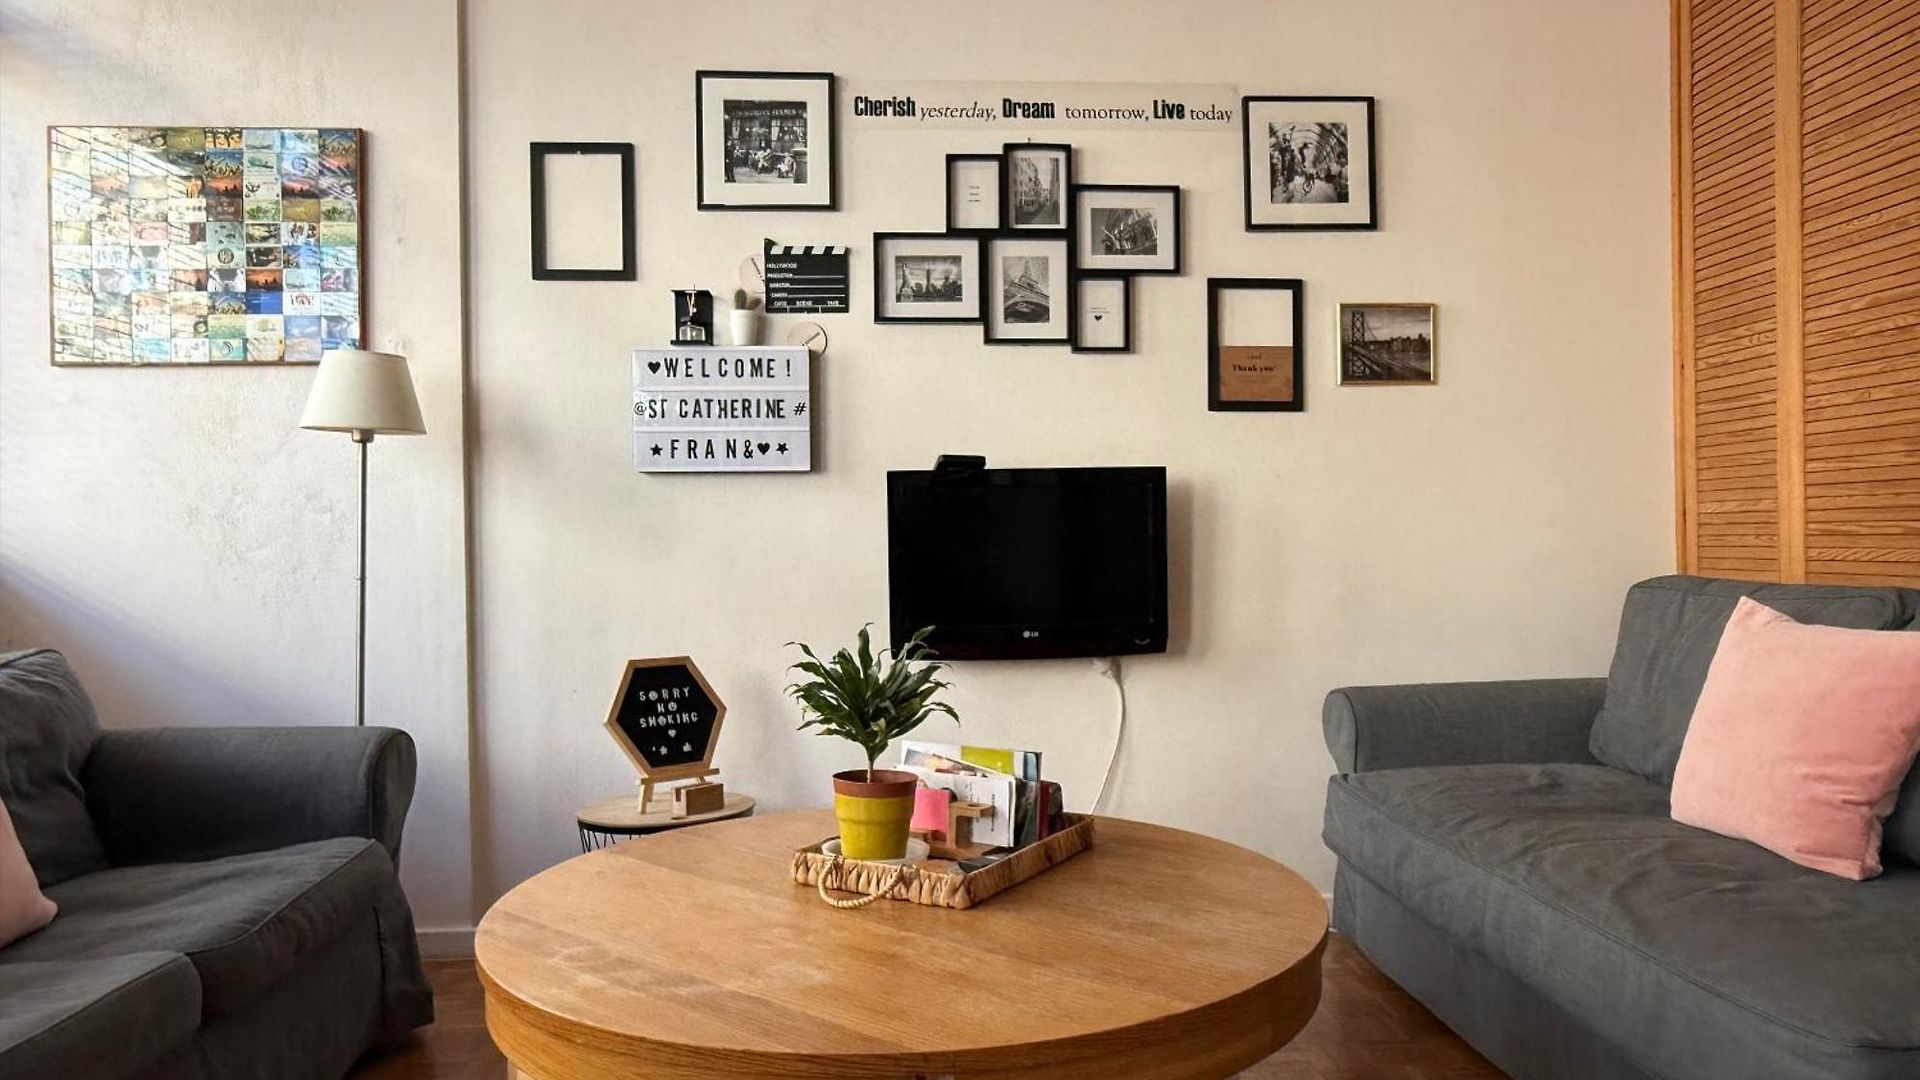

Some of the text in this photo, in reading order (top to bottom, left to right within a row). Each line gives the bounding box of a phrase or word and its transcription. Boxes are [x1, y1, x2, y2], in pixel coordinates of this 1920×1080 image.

[854, 96, 1233, 122] Cherish yesterday, Dream tomorrow, Live today
[679, 398, 786, 419] CATHERINE
[639, 686, 690, 701] SORRY
[657, 701, 677, 713] NO
[639, 711, 699, 728] SMOKING
